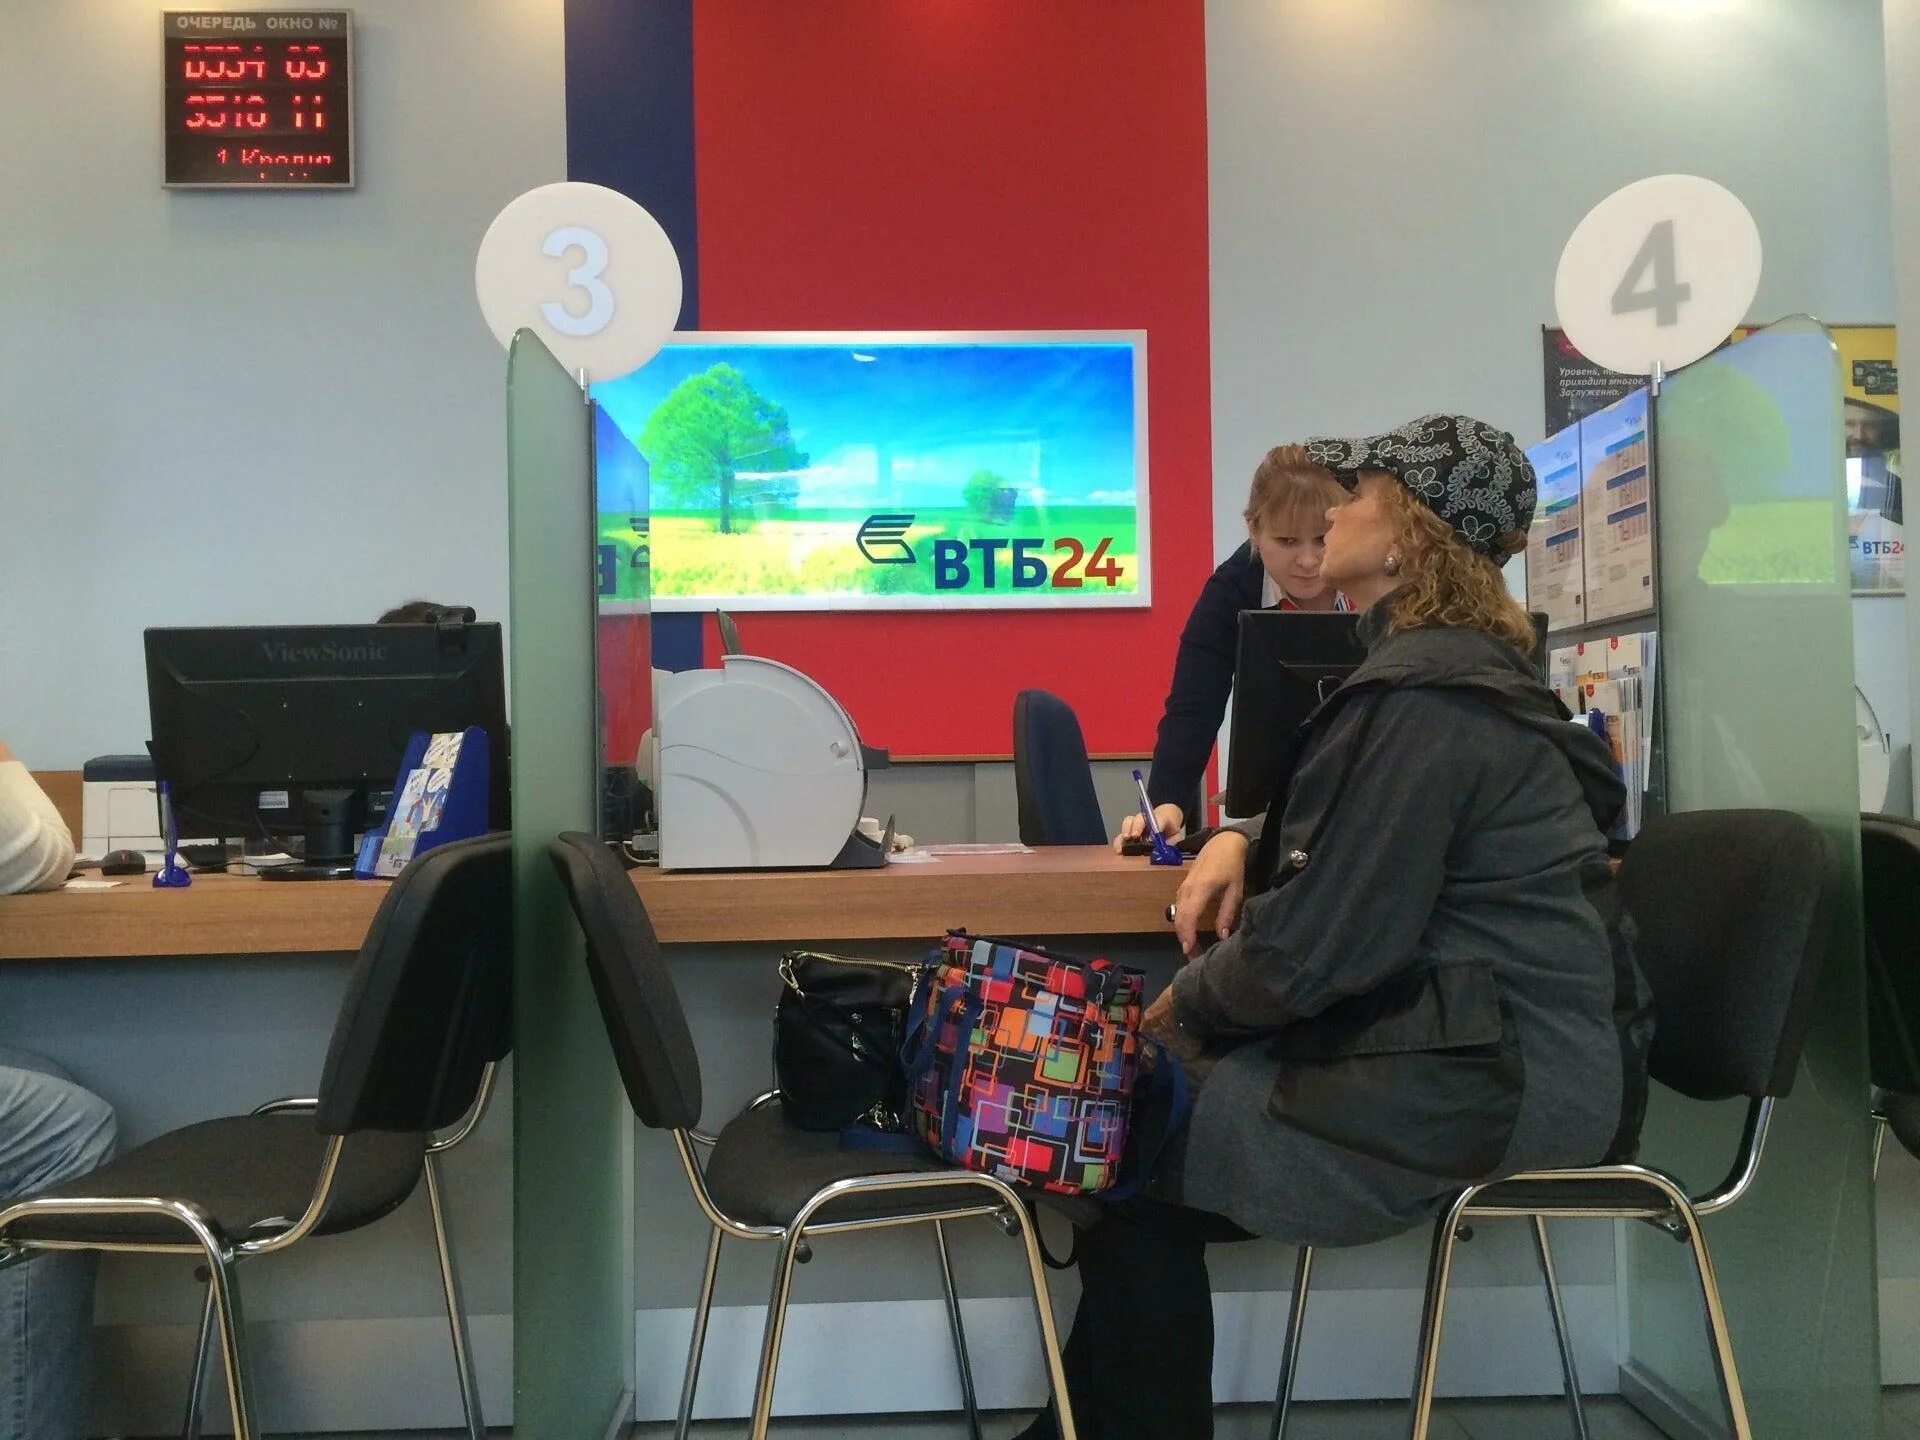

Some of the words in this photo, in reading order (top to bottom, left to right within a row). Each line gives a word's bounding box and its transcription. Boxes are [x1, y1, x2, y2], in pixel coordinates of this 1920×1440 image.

[177, 16, 257, 31] ОЧЕРЕДЬ
[266, 17, 313, 30] ОКНО
[319, 18, 338, 30] №
[539, 226, 615, 336] 3
[1611, 219, 1691, 327] 4
[1559, 377, 1607, 387] приходит
[934, 537, 1124, 590] ВТБ24
[261, 639, 388, 662] ViewSonic
